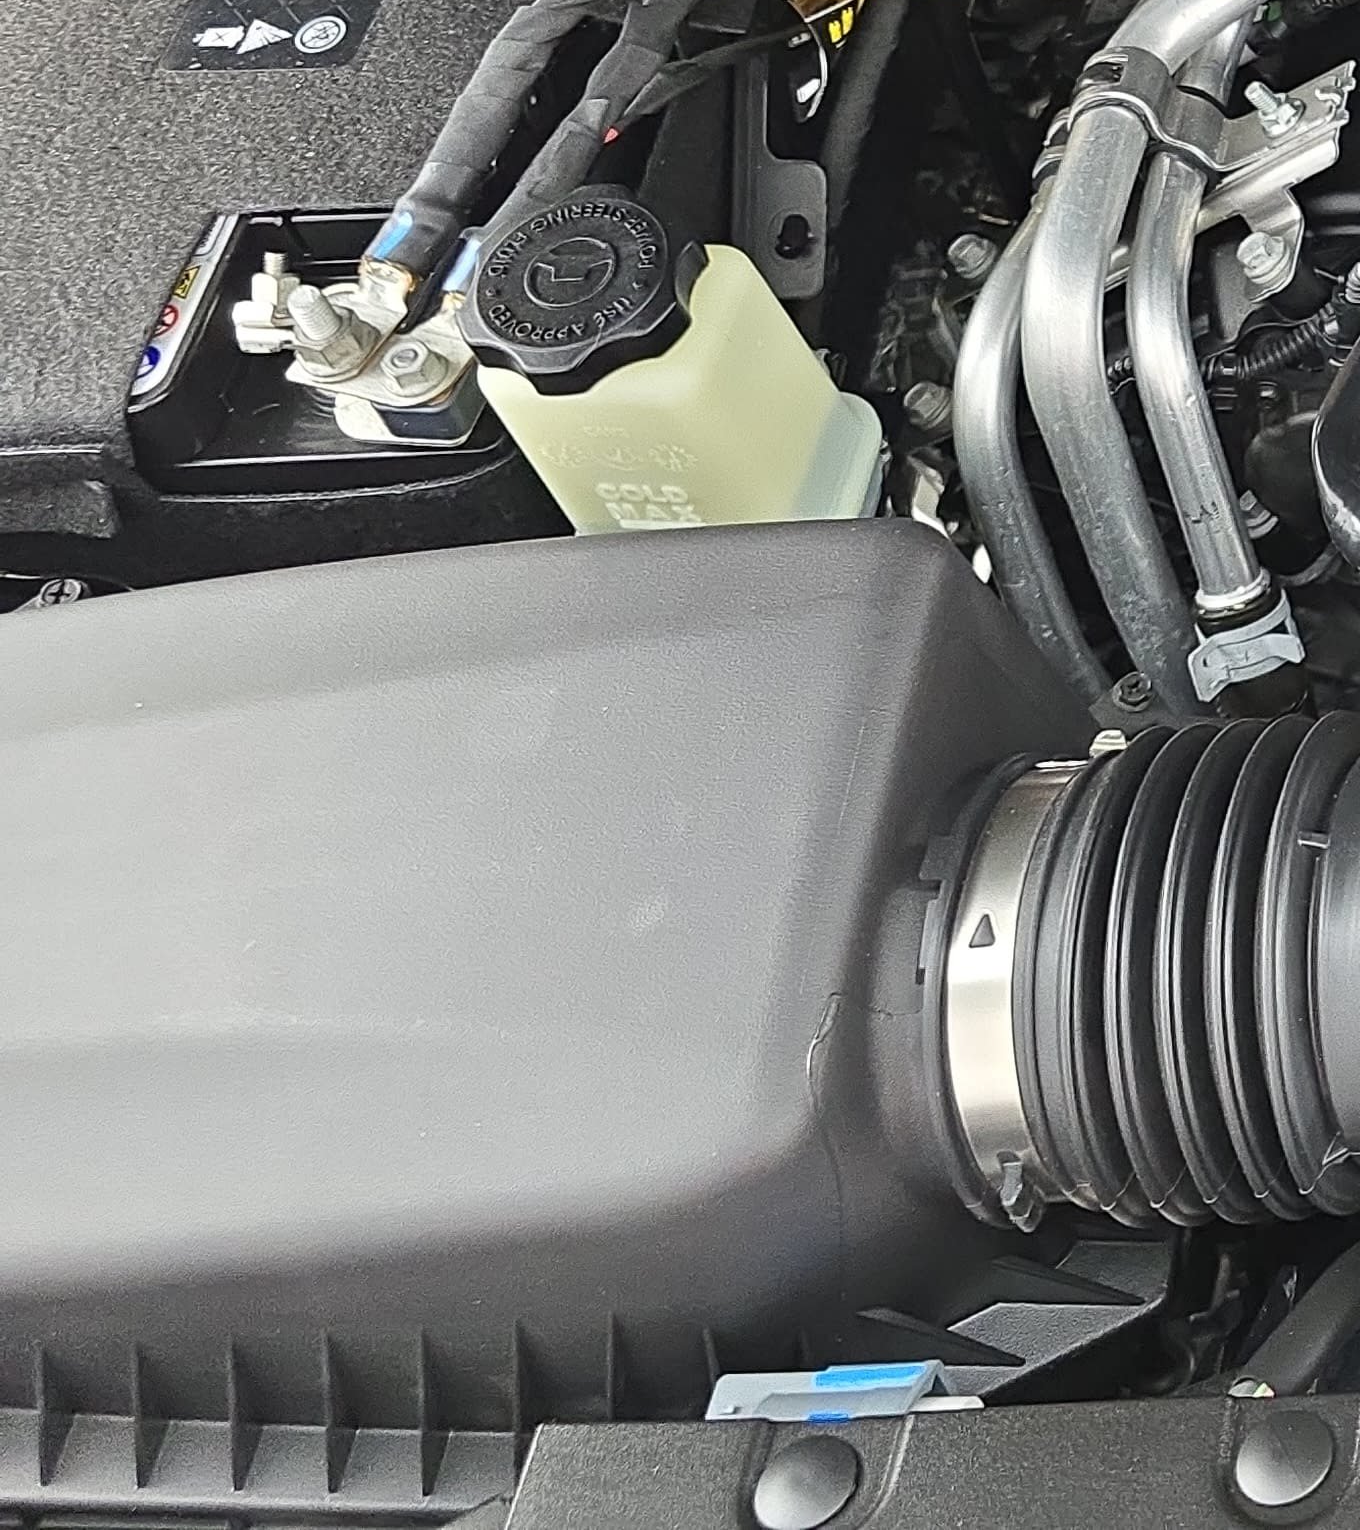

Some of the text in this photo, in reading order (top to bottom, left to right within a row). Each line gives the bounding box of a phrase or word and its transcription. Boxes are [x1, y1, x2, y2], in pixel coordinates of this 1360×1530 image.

[529, 202, 627, 233] STEERING
[486, 231, 527, 278] FLUID
[487, 296, 633, 341] USE APPROVED
[594, 482, 689, 503] COLD
[605, 502, 702, 522] MAX
